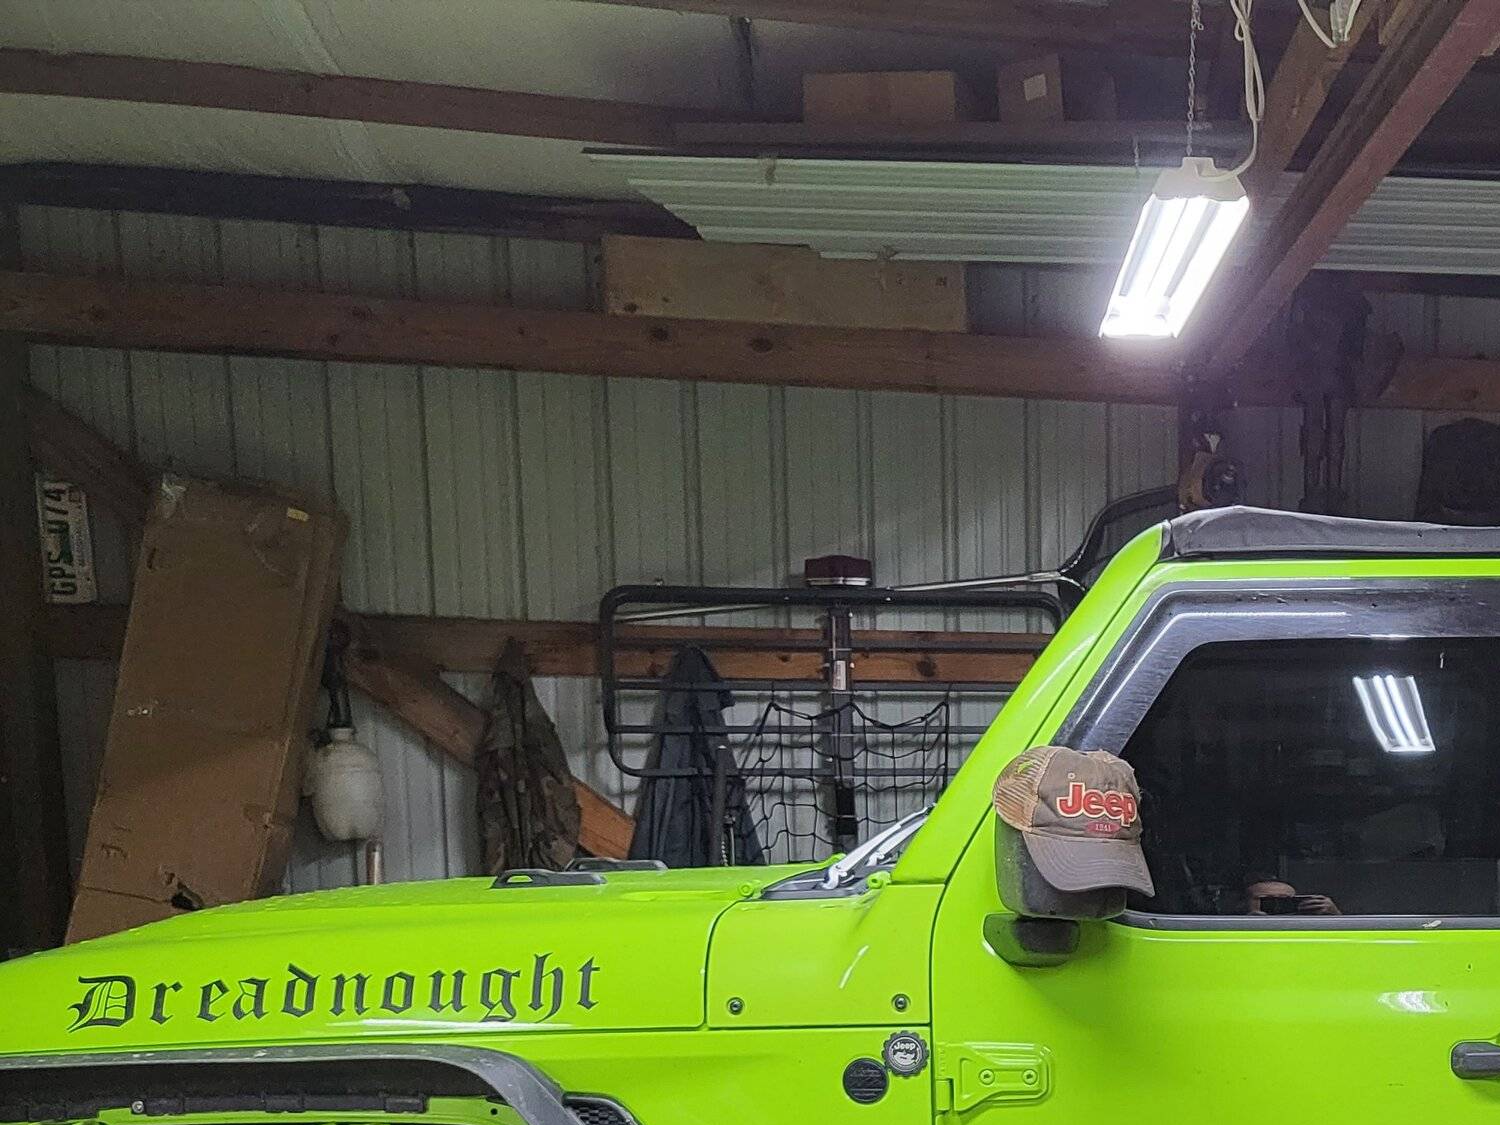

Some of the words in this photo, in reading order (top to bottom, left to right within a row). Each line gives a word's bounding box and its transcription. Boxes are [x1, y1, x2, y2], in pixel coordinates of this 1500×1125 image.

[1056, 782, 1137, 827] Jeep
[68, 952, 600, 1033] Dreadnought
[894, 1042, 916, 1051] Jeep
